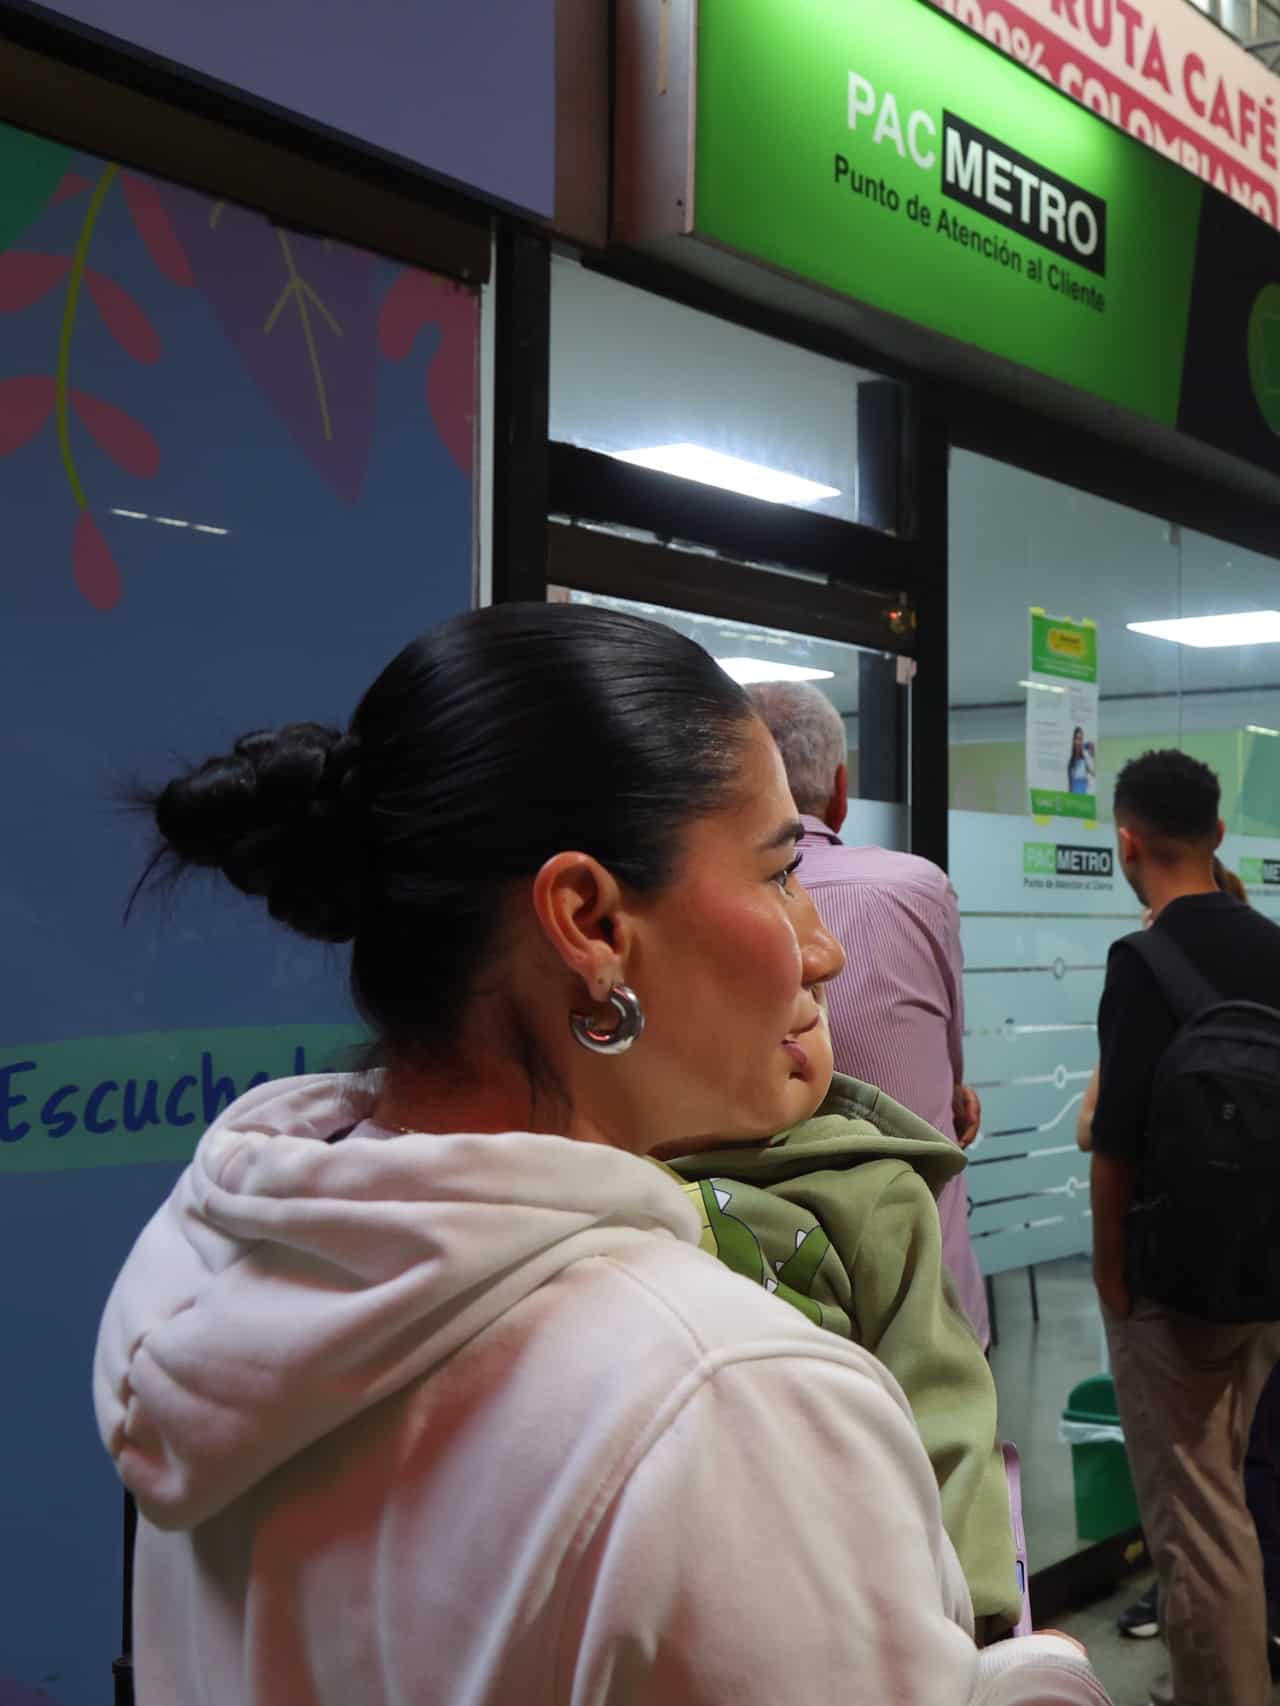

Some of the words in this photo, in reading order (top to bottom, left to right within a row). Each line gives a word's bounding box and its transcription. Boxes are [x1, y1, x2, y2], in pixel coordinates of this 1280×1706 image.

[944, 0, 1054, 83] 00%
[847, 71, 937, 170] PAC
[946, 126, 1099, 256] METRO
[1183, 52, 1278, 172] CAFÉ
[834, 153, 900, 212] Punto
[906, 194, 932, 227] de
[936, 208, 1023, 273] Atención
[1026, 258, 1043, 284] al
[1047, 264, 1106, 313] Cliente
[1057, 849, 1111, 873] METRO
[0, 1050, 271, 1143] Escuch
